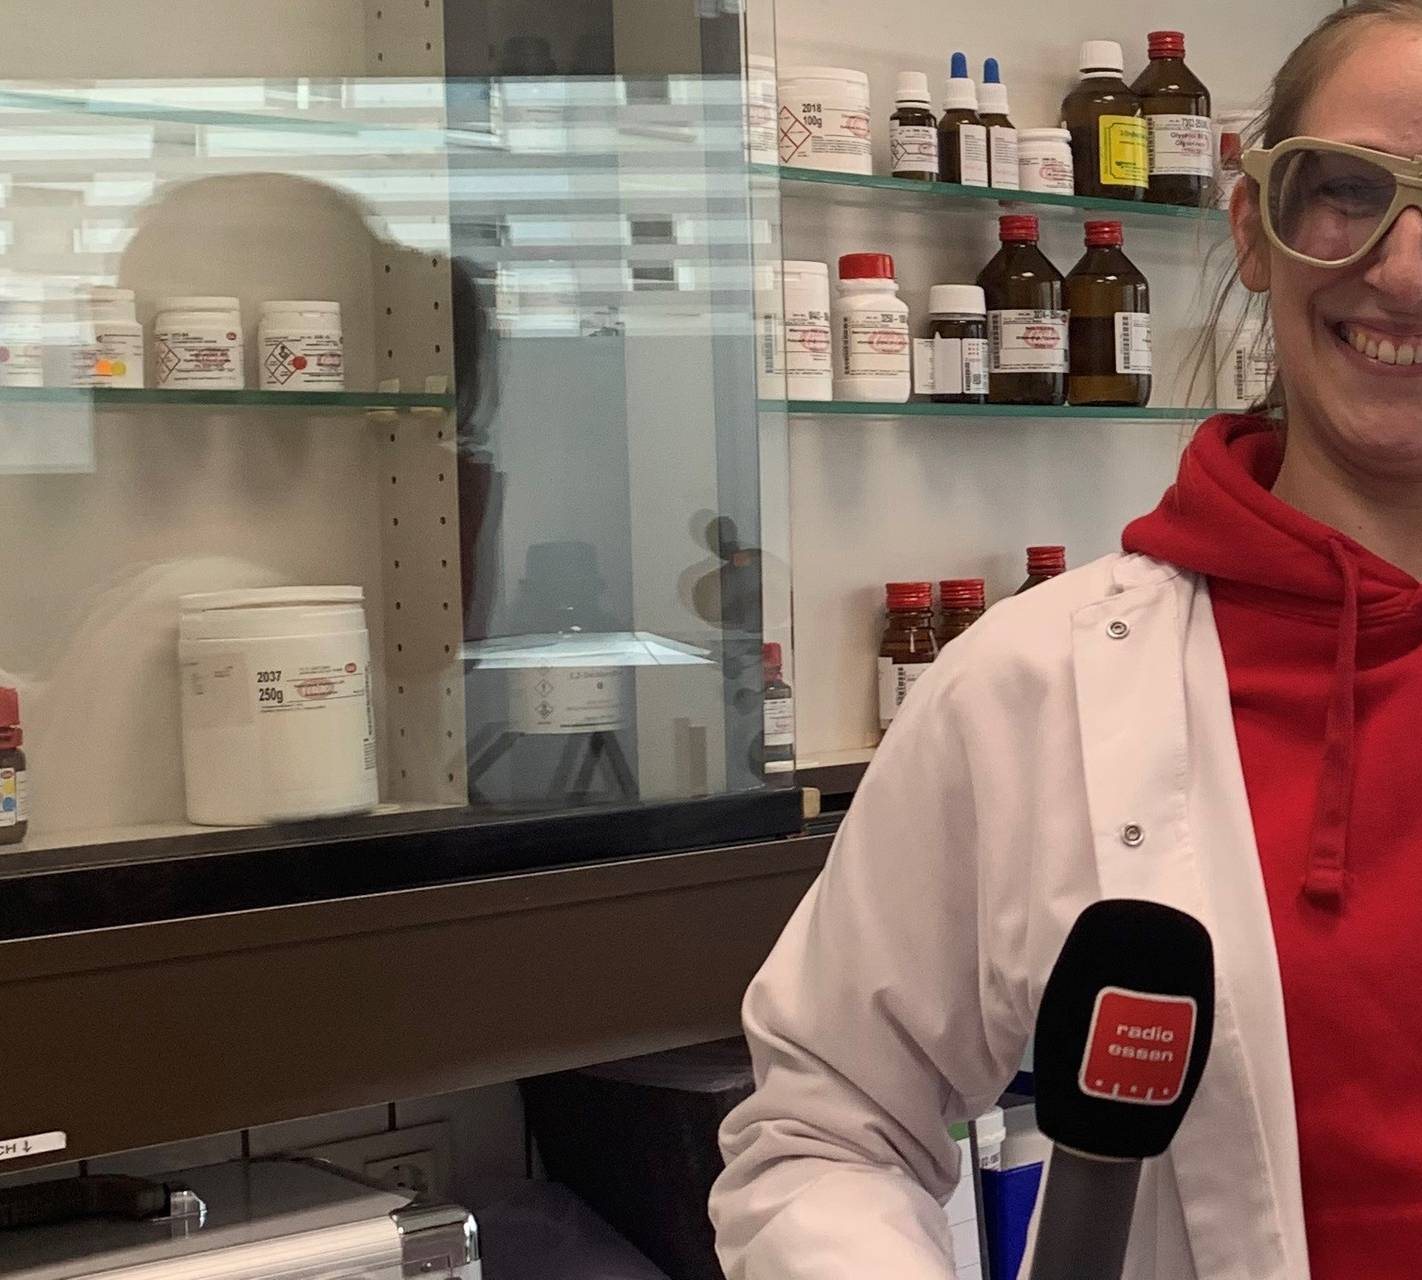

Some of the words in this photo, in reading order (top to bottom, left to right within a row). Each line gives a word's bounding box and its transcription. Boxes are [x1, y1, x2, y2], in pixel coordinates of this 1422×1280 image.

[802, 104, 822, 113] 2018
[803, 116, 823, 128] 100g
[256, 671, 282, 683] 2037
[259, 688, 284, 703] 250g
[1116, 1023, 1174, 1042] radio
[1108, 1044, 1174, 1063] essen
